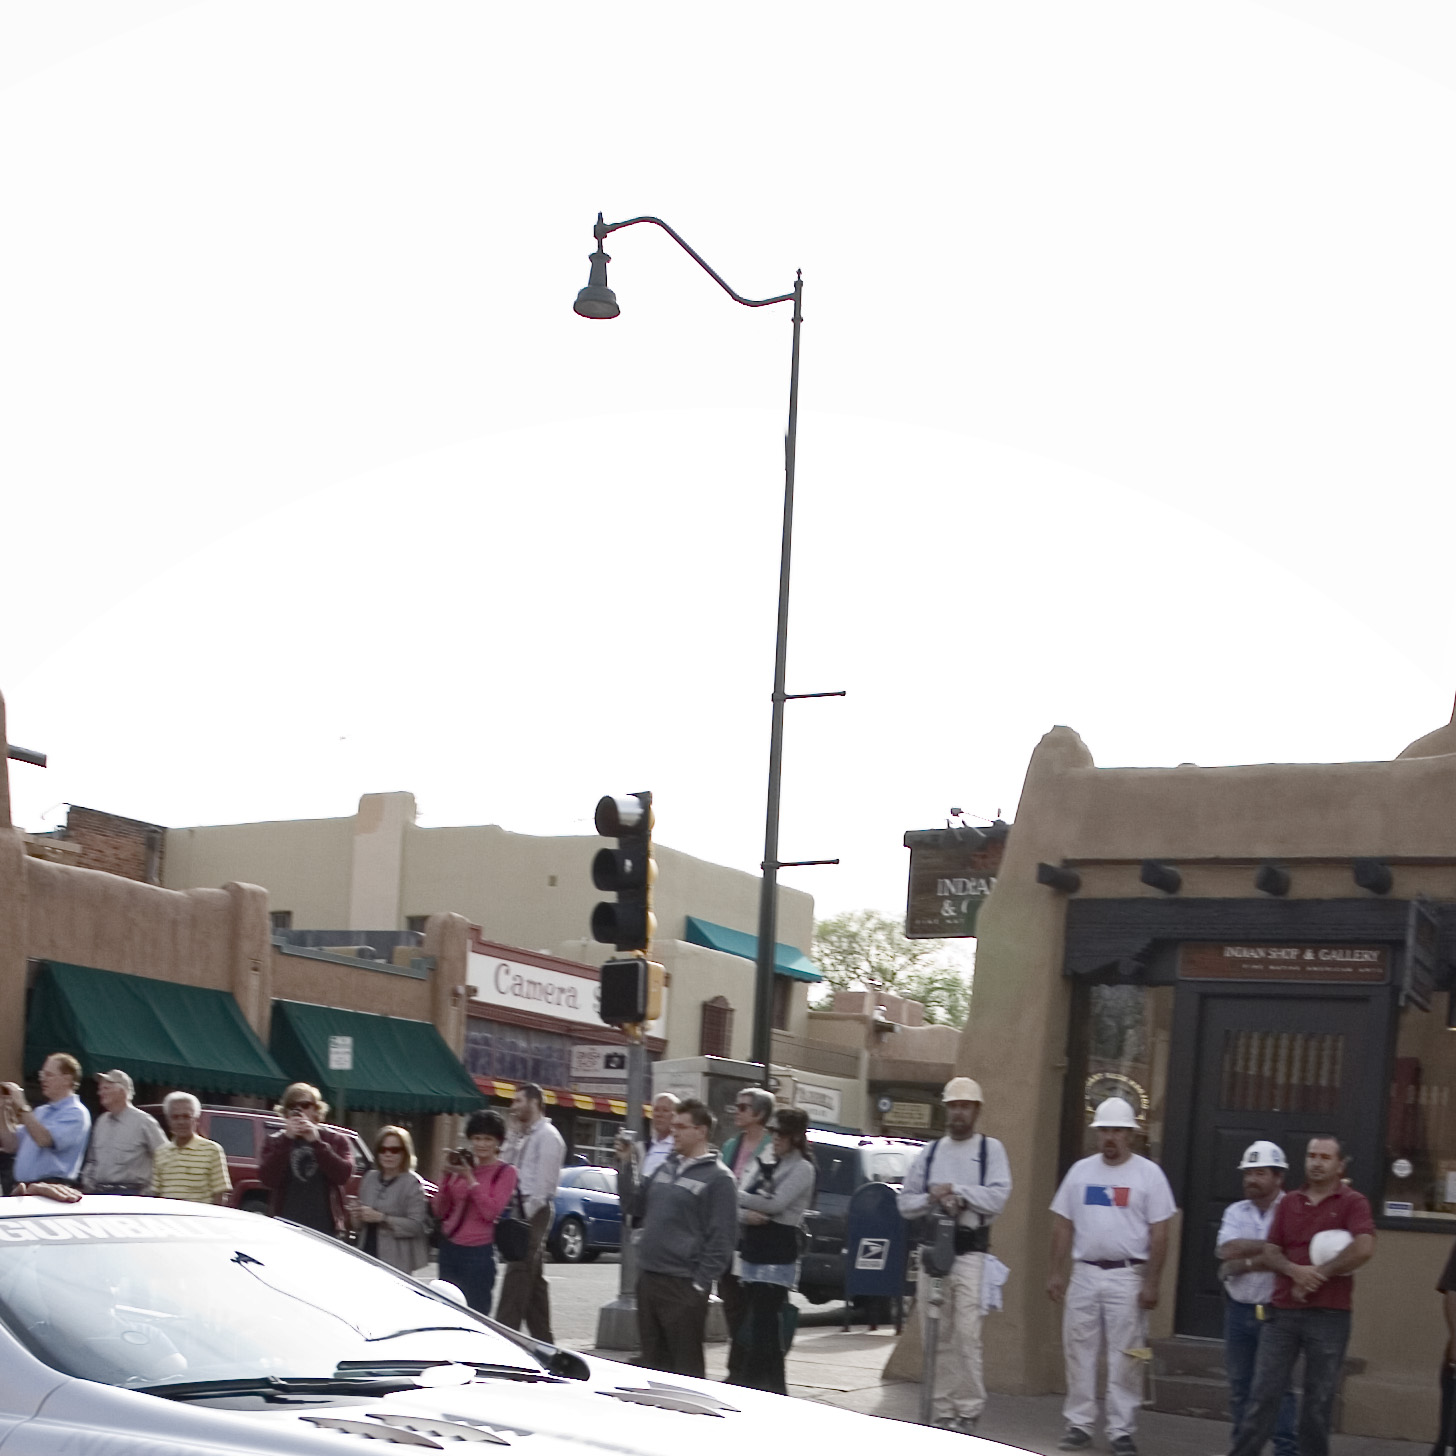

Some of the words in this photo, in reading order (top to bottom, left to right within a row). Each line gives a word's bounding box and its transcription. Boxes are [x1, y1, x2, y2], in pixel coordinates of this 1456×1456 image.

[1223, 946, 1266, 959] INDIAN
[1267, 947, 1300, 960] SHOP
[1302, 948, 1315, 960] &
[1318, 949, 1381, 962] GALLERY
[495, 963, 581, 1009] Camera
